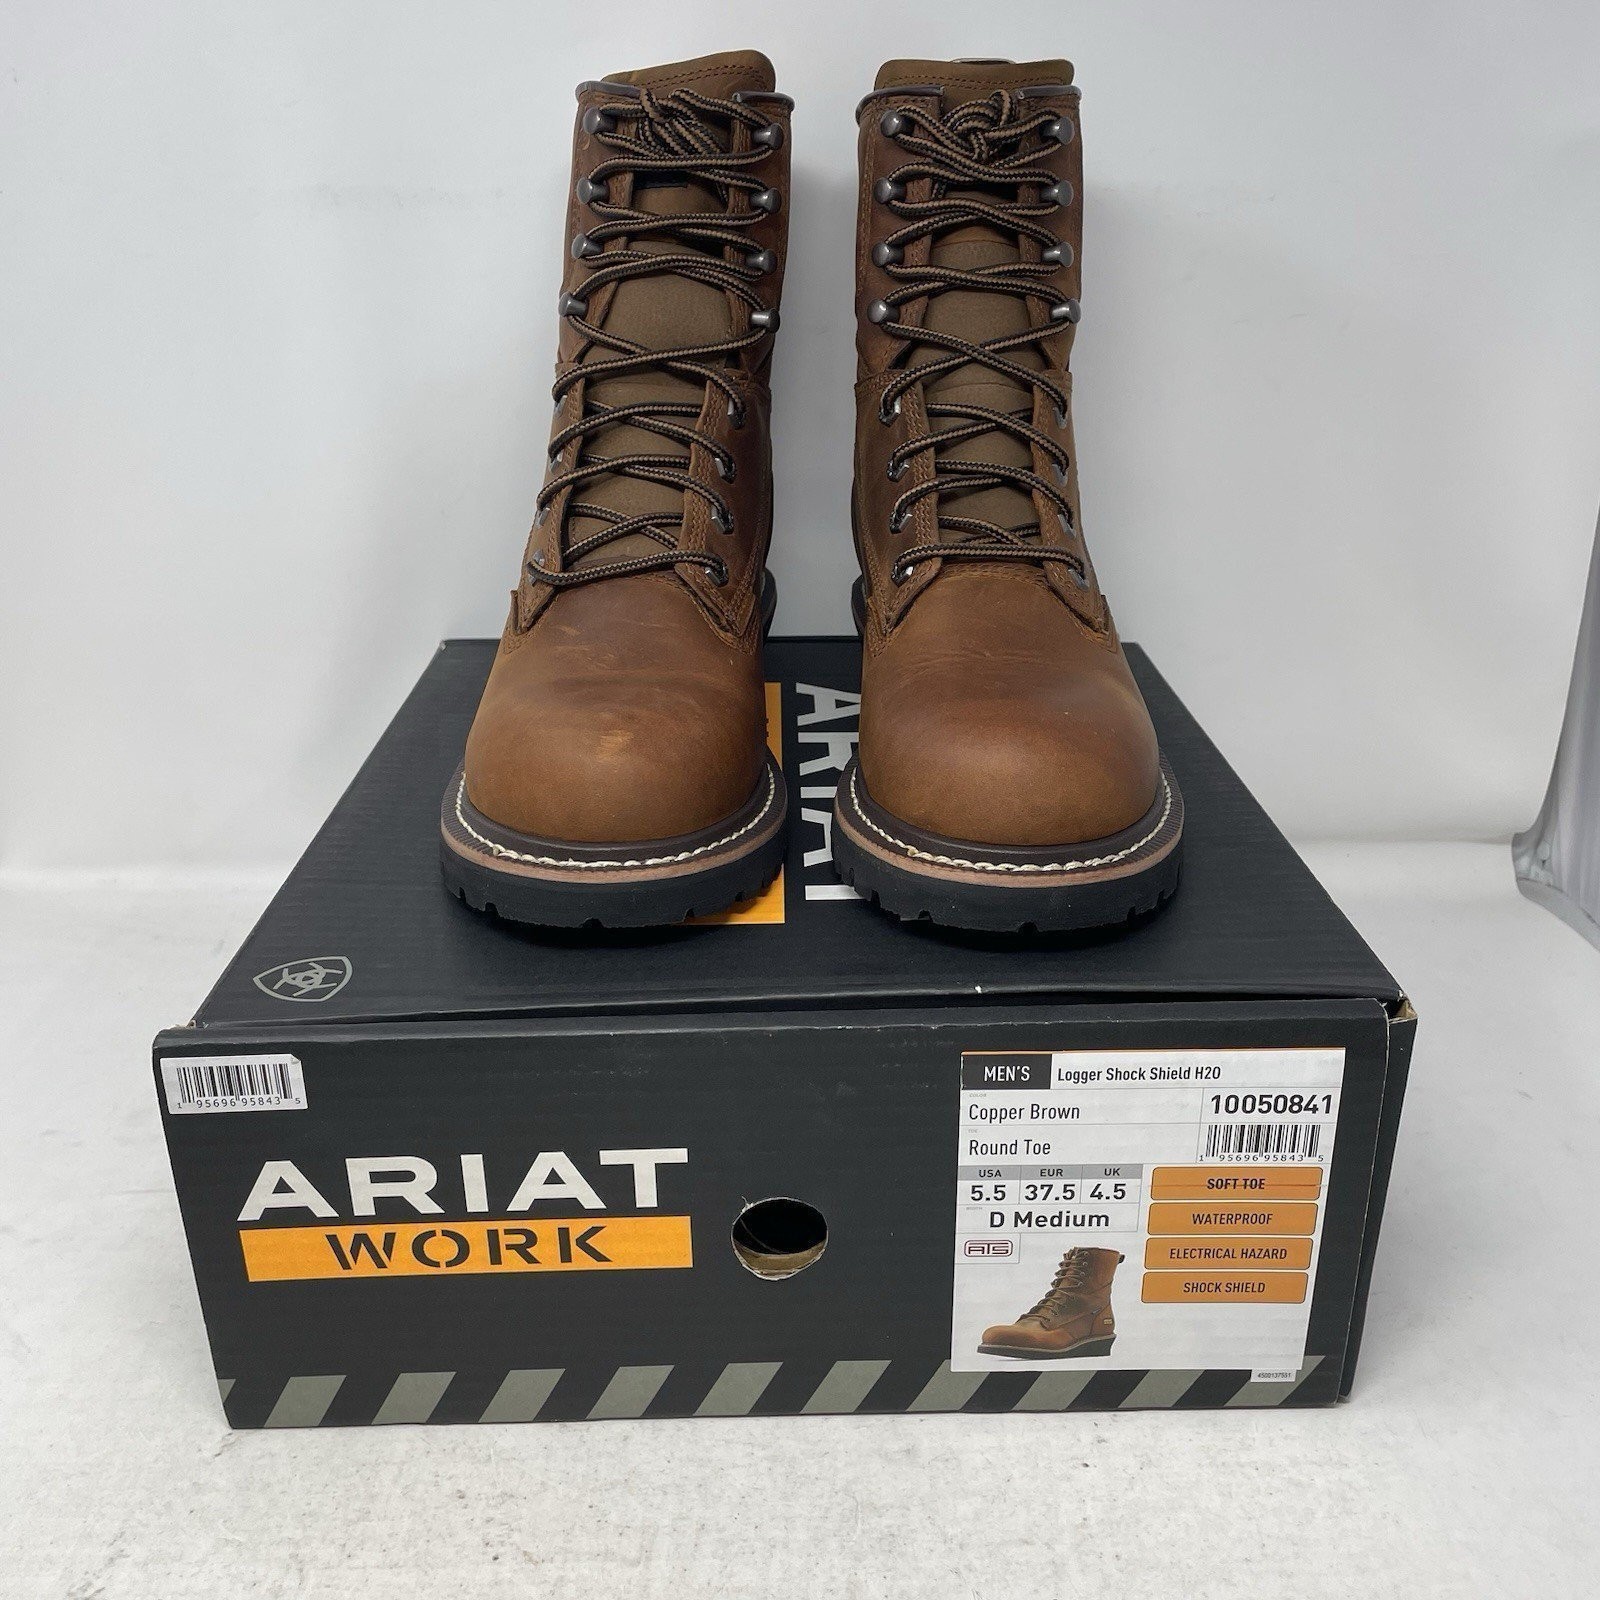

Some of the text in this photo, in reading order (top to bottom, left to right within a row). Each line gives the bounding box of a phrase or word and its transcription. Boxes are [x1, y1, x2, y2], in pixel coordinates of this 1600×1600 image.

[984, 1065, 1031, 1082] MEN'S
[1058, 1067, 1101, 1084] Logger
[1106, 1066, 1146, 1081] Shock
[1150, 1066, 1190, 1080] Shield
[196, 1098, 236, 1109] 95696
[241, 1096, 281, 1106] 95843
[1211, 1094, 1332, 1115] 10050841
[969, 1103, 1080, 1124] Copper Brown
[969, 1139, 1051, 1156] Round Toe
[1219, 1154, 1259, 1162] 95696
[1264, 1154, 1304, 1162] 95843
[979, 1169, 1002, 1178] USA
[1040, 1168, 1064, 1177] EUR
[1104, 1167, 1121, 1176] UK
[237, 1147, 689, 1221] ARIAT
[970, 1184, 1006, 1201] 5.5
[1024, 1184, 1076, 1201] 37.5
[1089, 1183, 1127, 1200] 4.5
[1206, 1178, 1266, 1190] SOFT TOE
[990, 1210, 1110, 1228] D Medium
[1192, 1213, 1273, 1225] WATERPROOF
[325, 1225, 612, 1271] WORK
[967, 1242, 1009, 1255] ATS
[1169, 1248, 1288, 1260] ELECTRICAL HAZARD
[1183, 1282, 1266, 1293] SHOCK SHIELD
